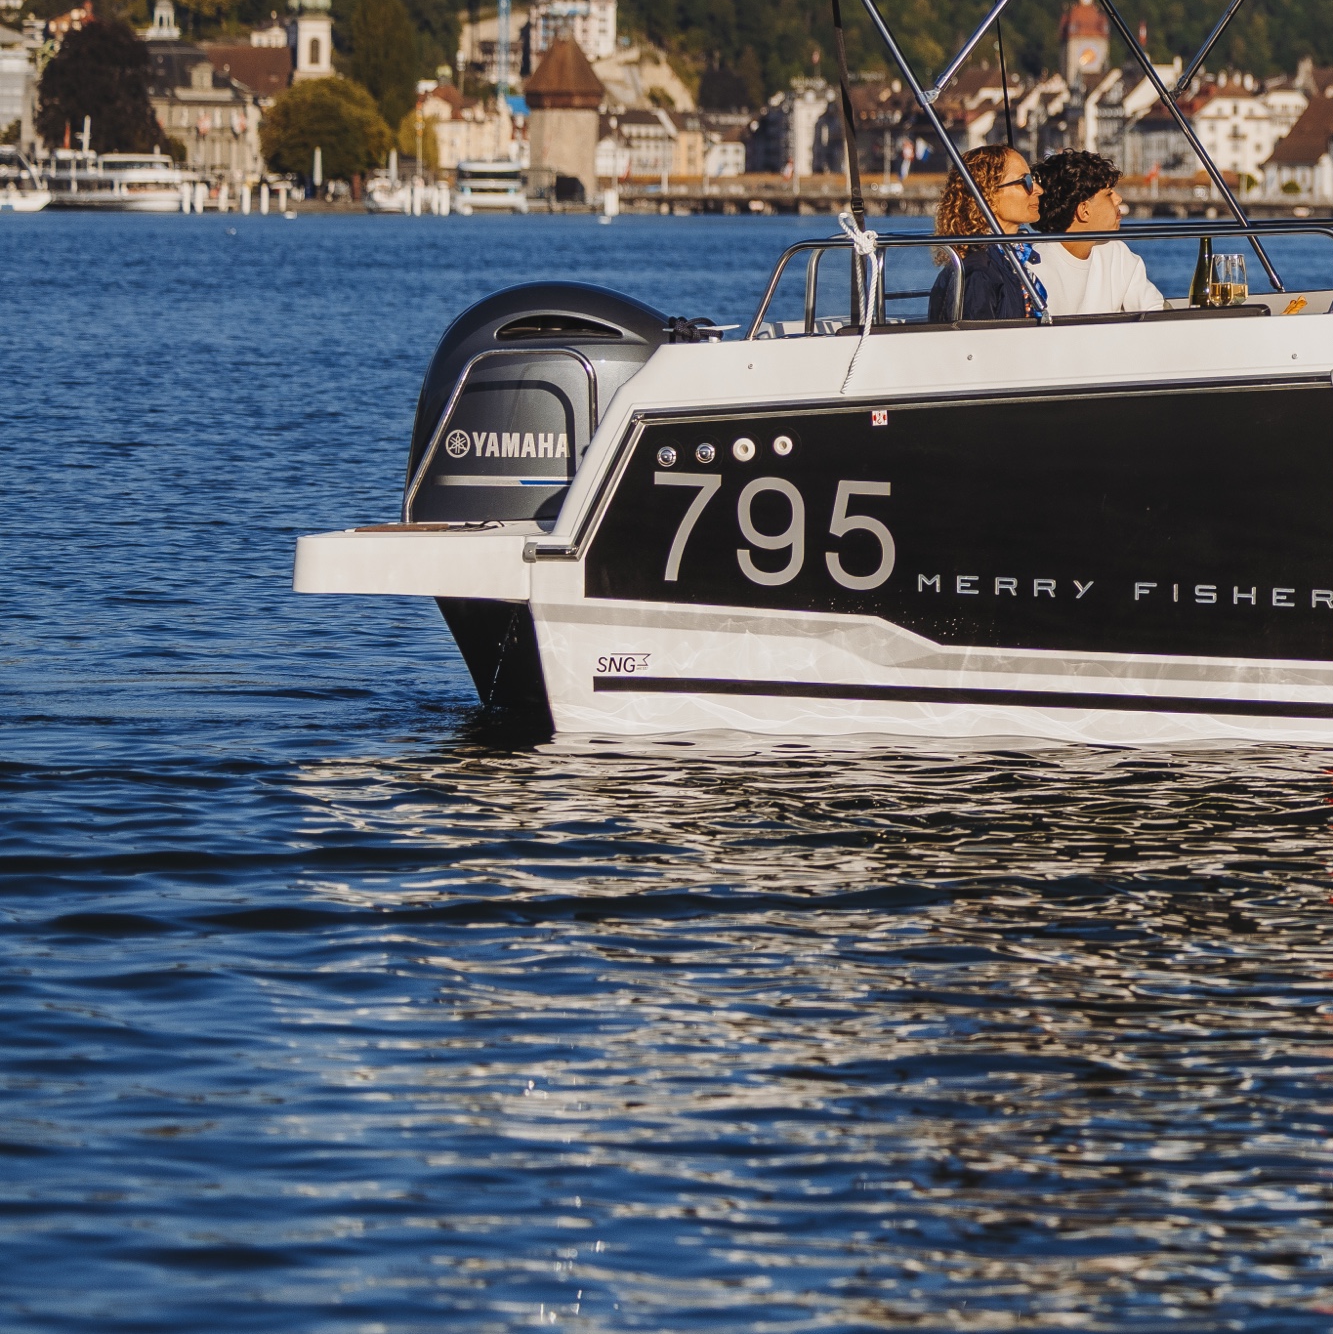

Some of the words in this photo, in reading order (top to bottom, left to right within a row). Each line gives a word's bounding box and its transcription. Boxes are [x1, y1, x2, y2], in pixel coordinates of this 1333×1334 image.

[472, 431, 571, 458] YAMAHA
[654, 471, 896, 590] 795
[918, 573, 1094, 599] MERRY
[596, 656, 636, 673] SNG
